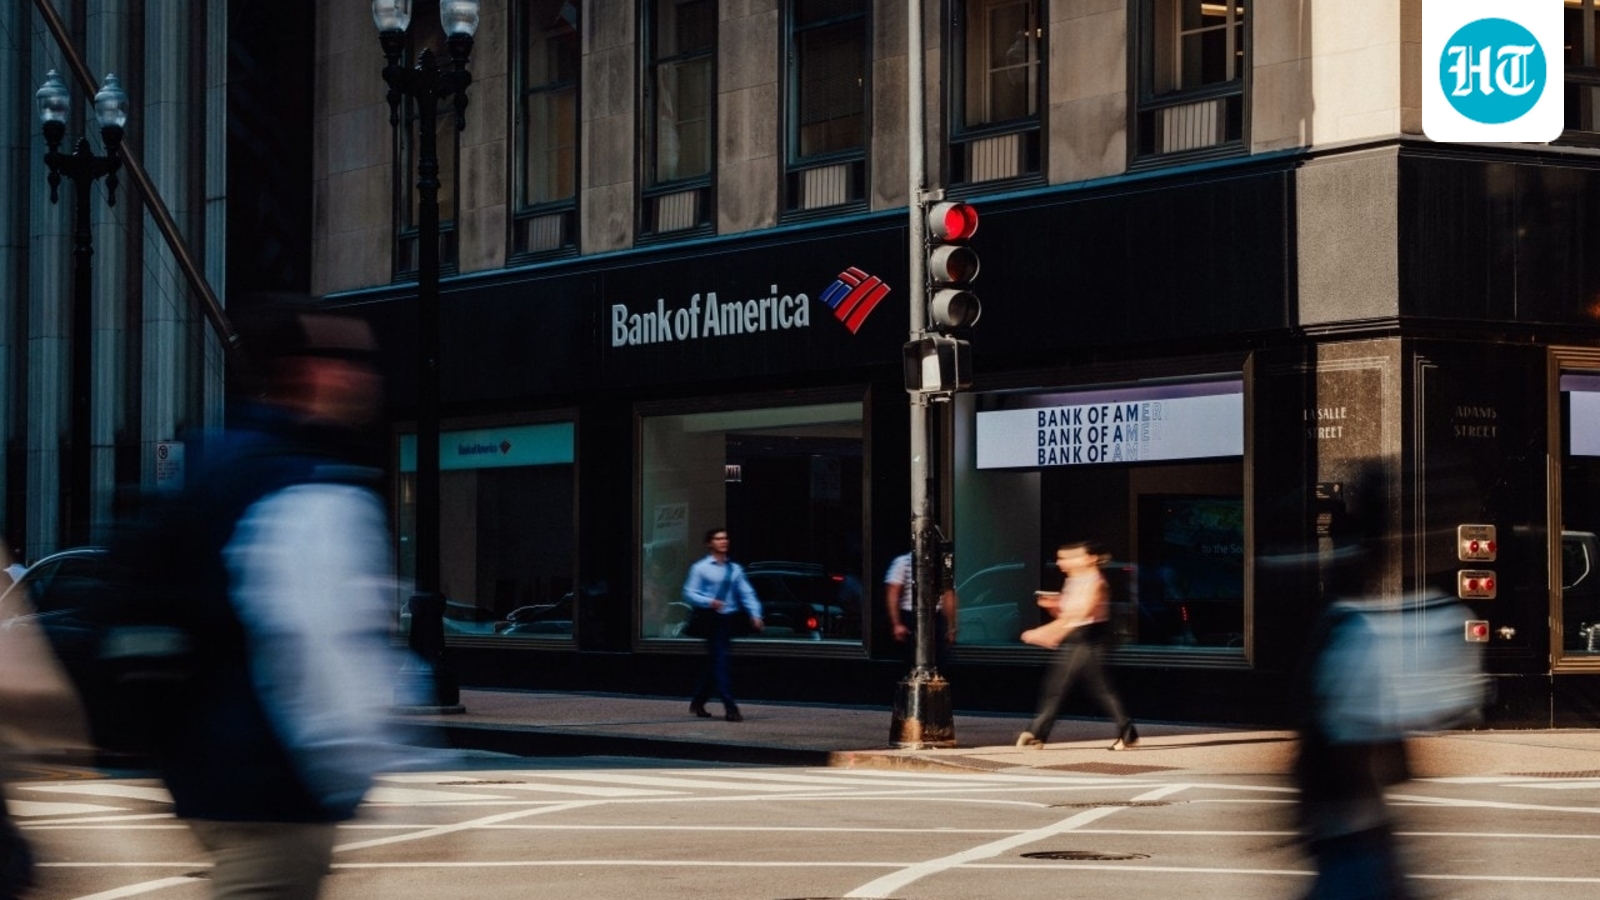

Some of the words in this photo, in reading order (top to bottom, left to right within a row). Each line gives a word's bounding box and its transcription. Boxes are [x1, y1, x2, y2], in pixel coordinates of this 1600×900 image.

[612, 298, 674, 348] Bank
[674, 292, 701, 342] of
[702, 284, 810, 338] America
[1037, 407, 1083, 428] BANK
[1087, 405, 1109, 425] OF
[1455, 404, 1498, 419] ADAMS
[1037, 426, 1083, 447] BANK
[1087, 424, 1109, 444] OF
[1453, 424, 1497, 439] STREET
[1037, 445, 1083, 465] BANK
[1087, 443, 1108, 463] OF
